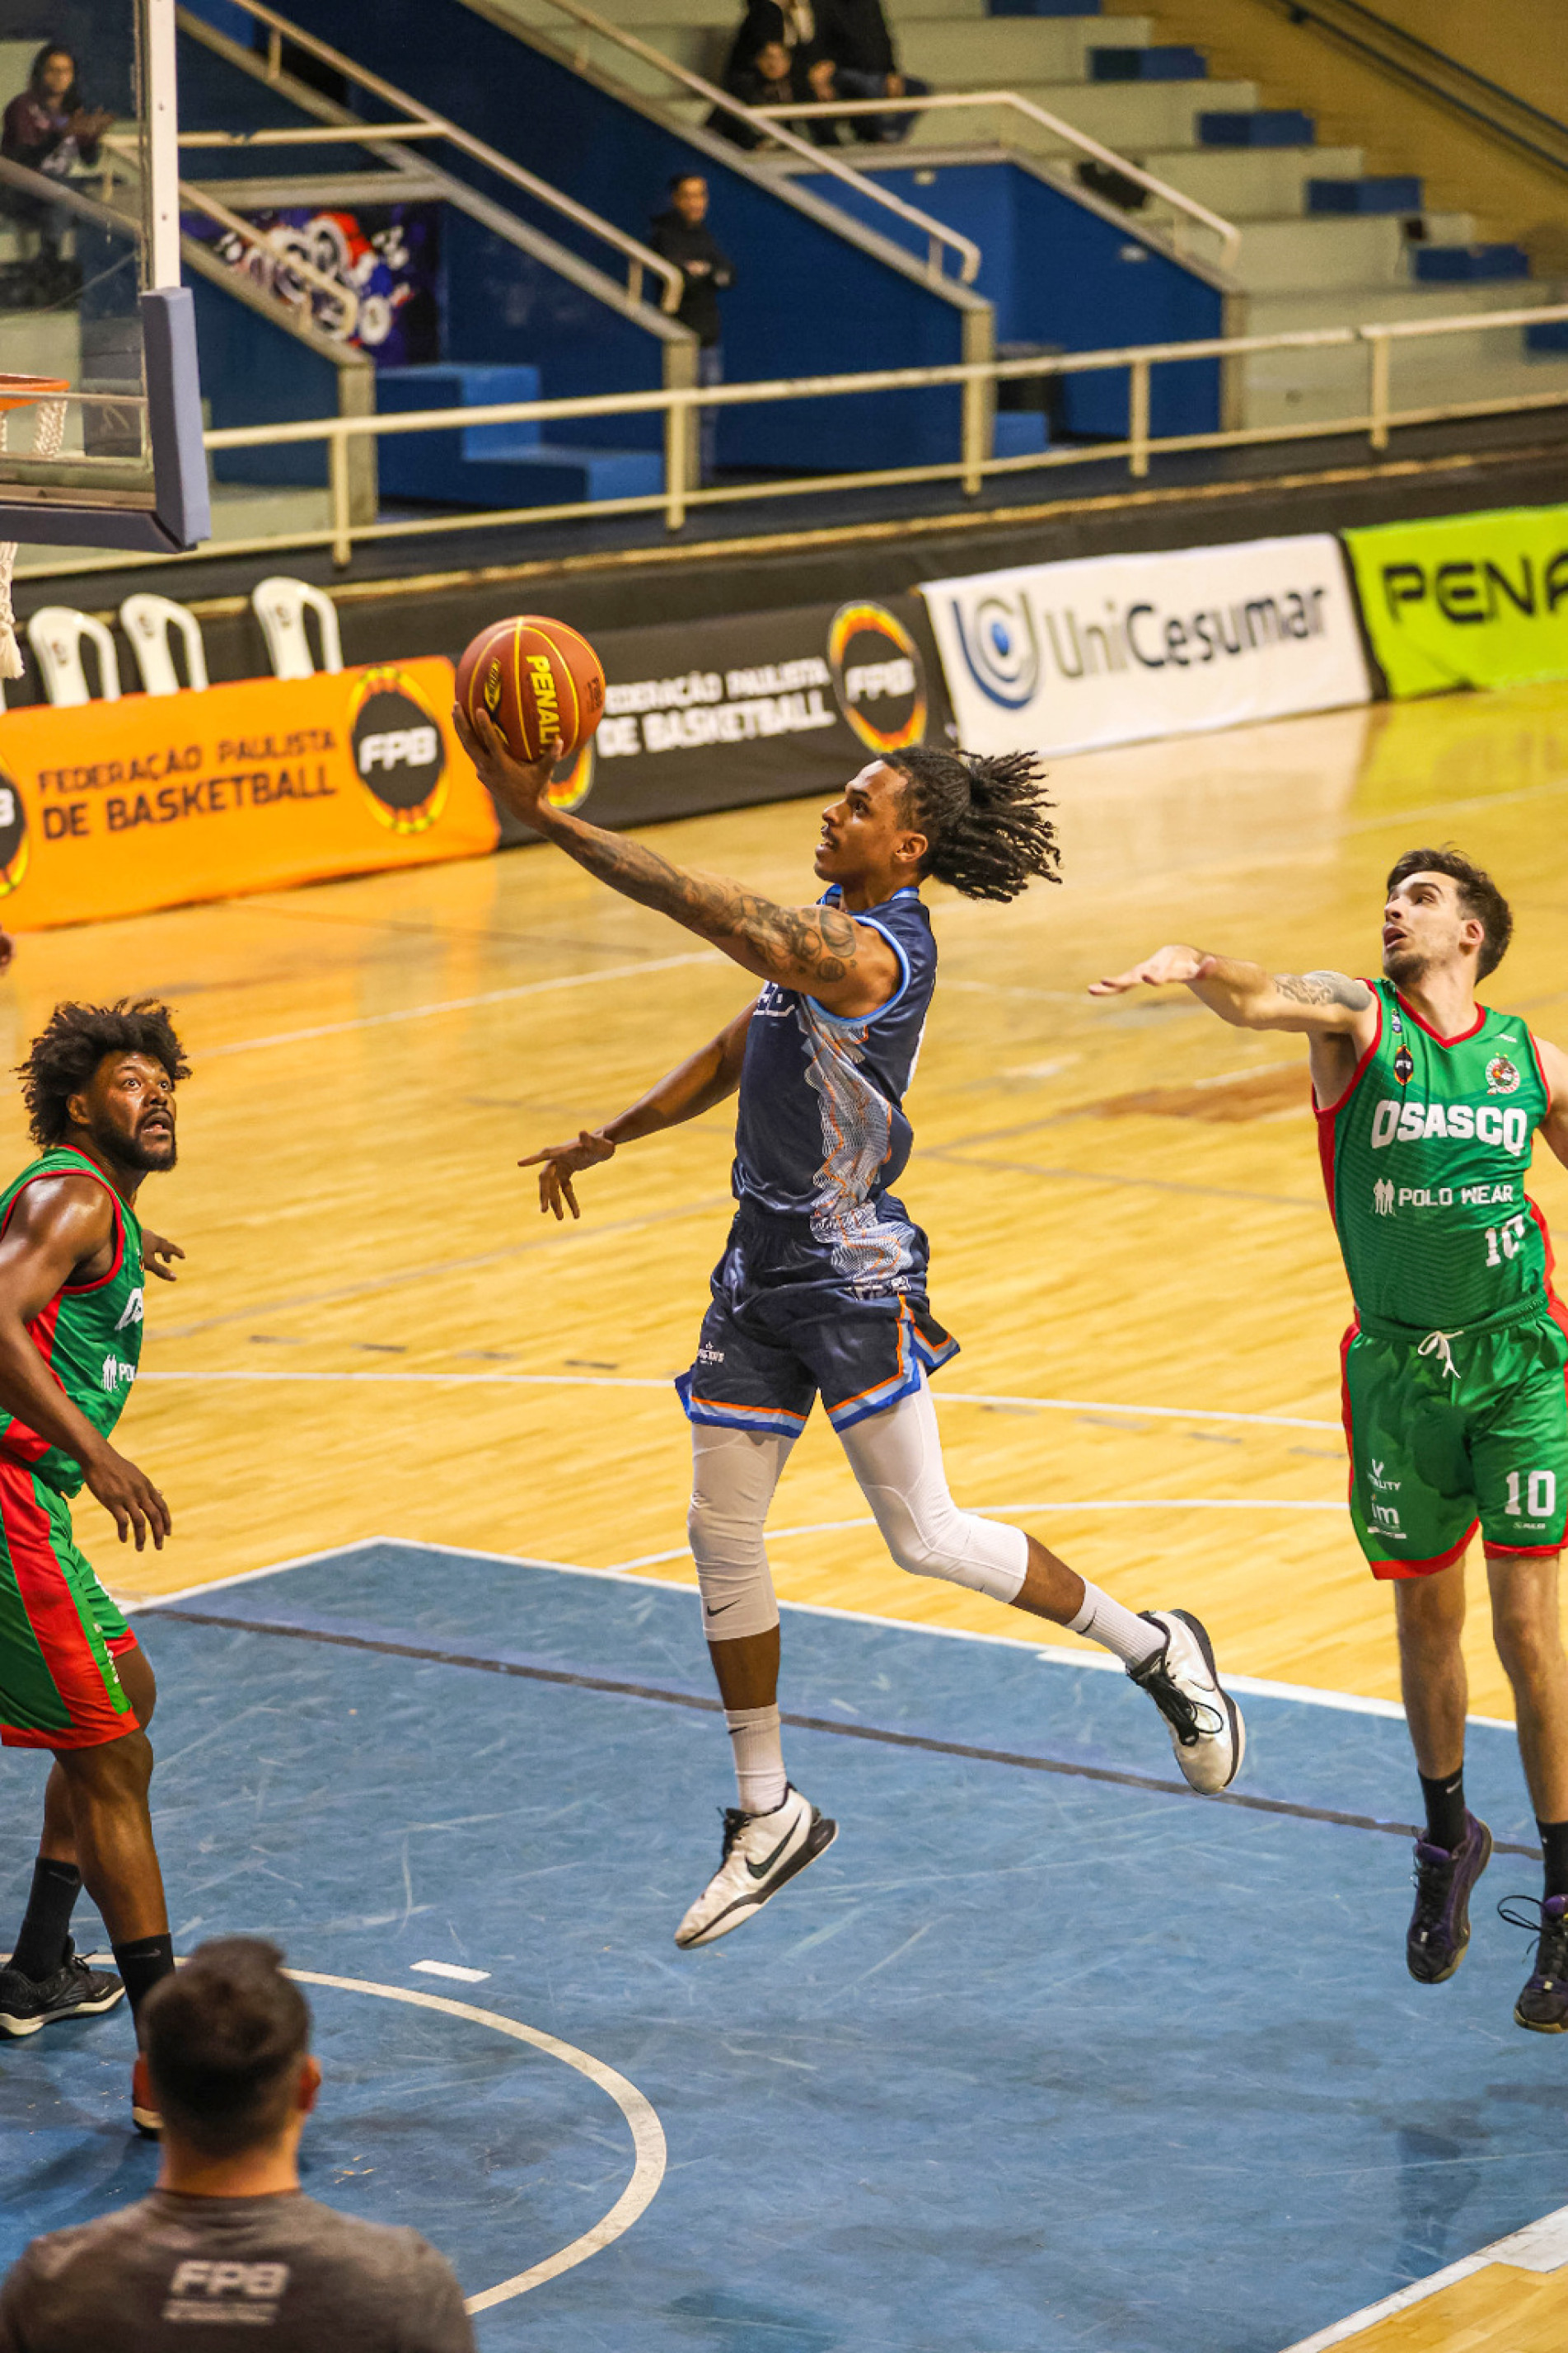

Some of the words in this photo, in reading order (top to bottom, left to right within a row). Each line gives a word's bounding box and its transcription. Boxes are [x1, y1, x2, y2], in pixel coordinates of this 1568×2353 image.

[1045, 587, 1325, 679] UniCesumar
[725, 657, 832, 700] PAULISTA
[845, 658, 916, 702] FPB
[218, 728, 335, 763] PAULISTA
[597, 715, 641, 758] DE
[643, 690, 837, 753] BASKETBALL
[359, 726, 437, 773] FPB
[43, 802, 88, 840] DE
[106, 765, 336, 831] BASKETBALL
[1398, 1188, 1453, 1207] POLO
[1461, 1185, 1514, 1204] WEAR
[1505, 1471, 1556, 1517] 10
[170, 2260, 290, 2296] FPB
